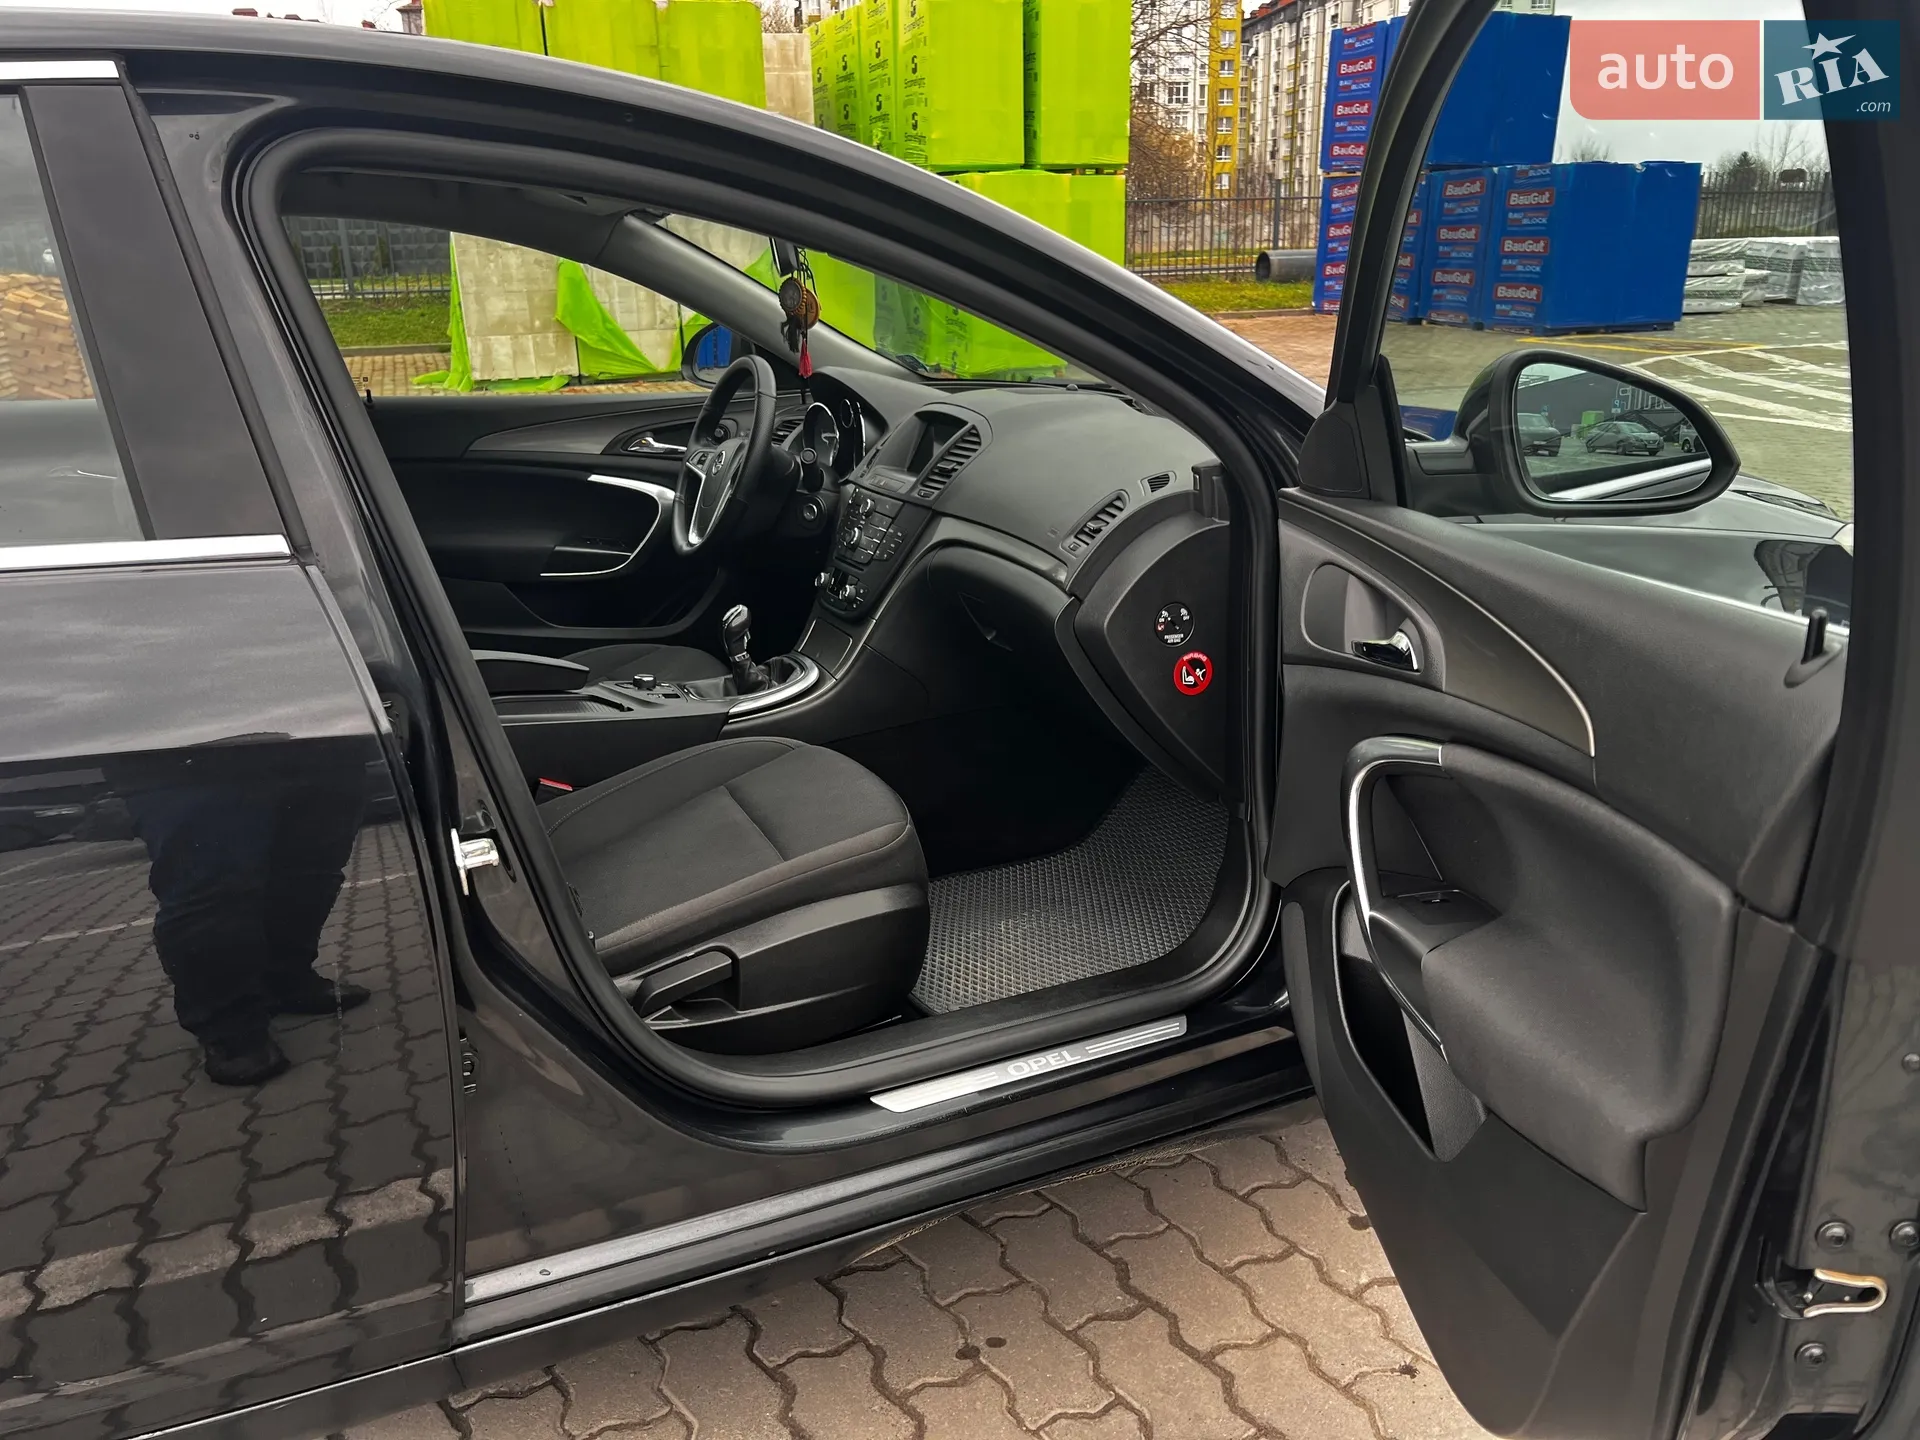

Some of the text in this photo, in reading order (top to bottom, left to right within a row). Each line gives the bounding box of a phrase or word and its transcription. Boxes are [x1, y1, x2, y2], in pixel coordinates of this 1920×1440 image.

[1340, 59, 1372, 74] BauGut
[1337, 103, 1369, 115] BauGut
[1332, 145, 1365, 156] BauGut
[1446, 181, 1481, 196] BauGut
[1510, 192, 1549, 205] BauGut
[1440, 228, 1476, 239] BauGut
[1504, 240, 1545, 252] BauGut
[1435, 272, 1470, 284] BauGut
[1497, 286, 1538, 300] BauGut
[1006, 1049, 1081, 1076] OPEL
